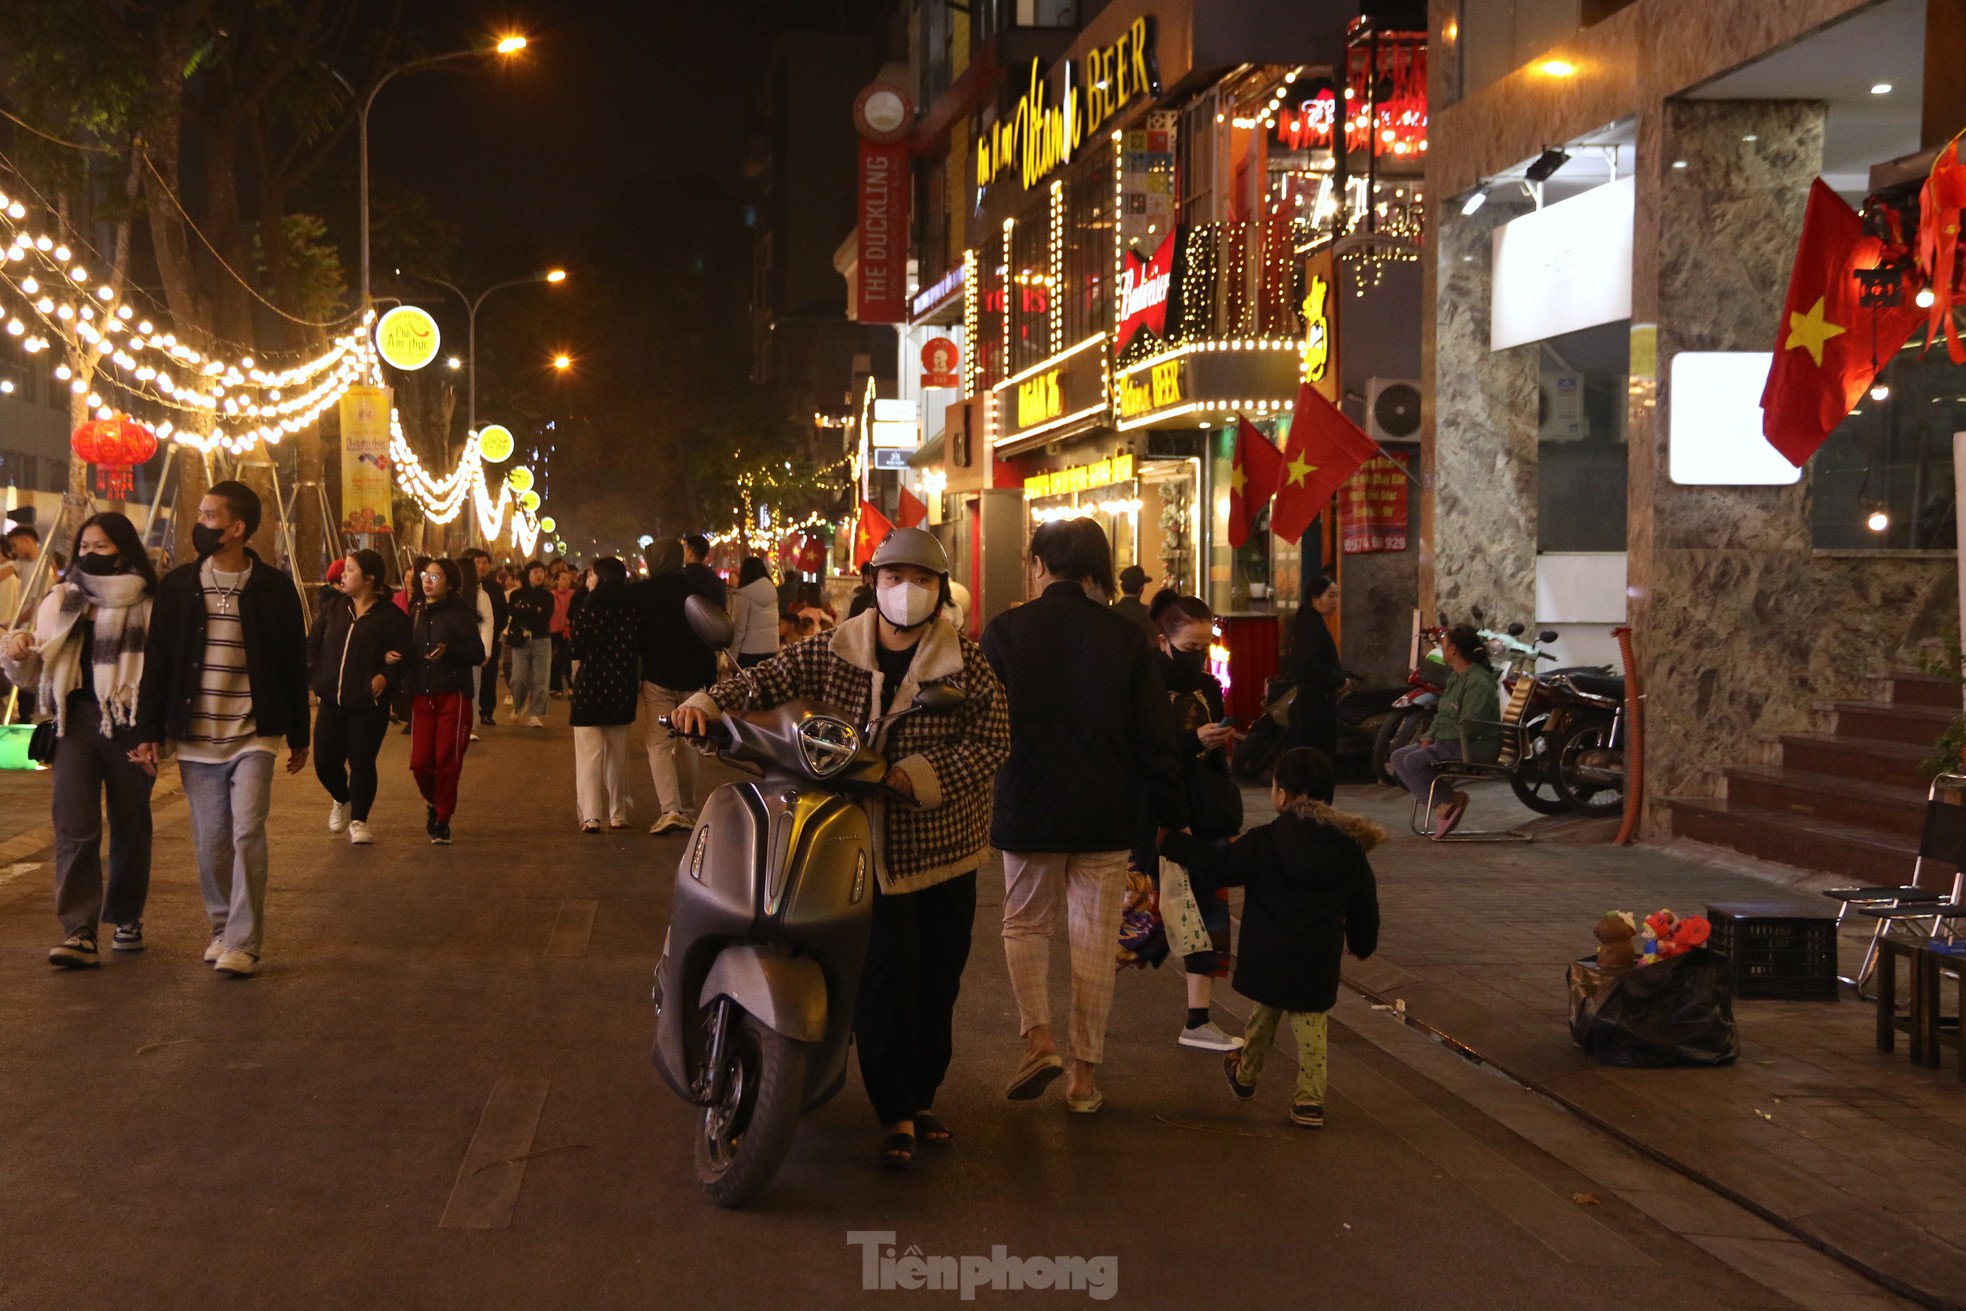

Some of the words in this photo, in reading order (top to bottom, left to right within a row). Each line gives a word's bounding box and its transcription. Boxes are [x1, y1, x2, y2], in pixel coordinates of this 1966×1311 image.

[1086, 16, 1150, 137] BEER
[865, 156, 889, 261] DUCKLING
[864, 266, 886, 304] THE
[1152, 359, 1181, 408] BEER
